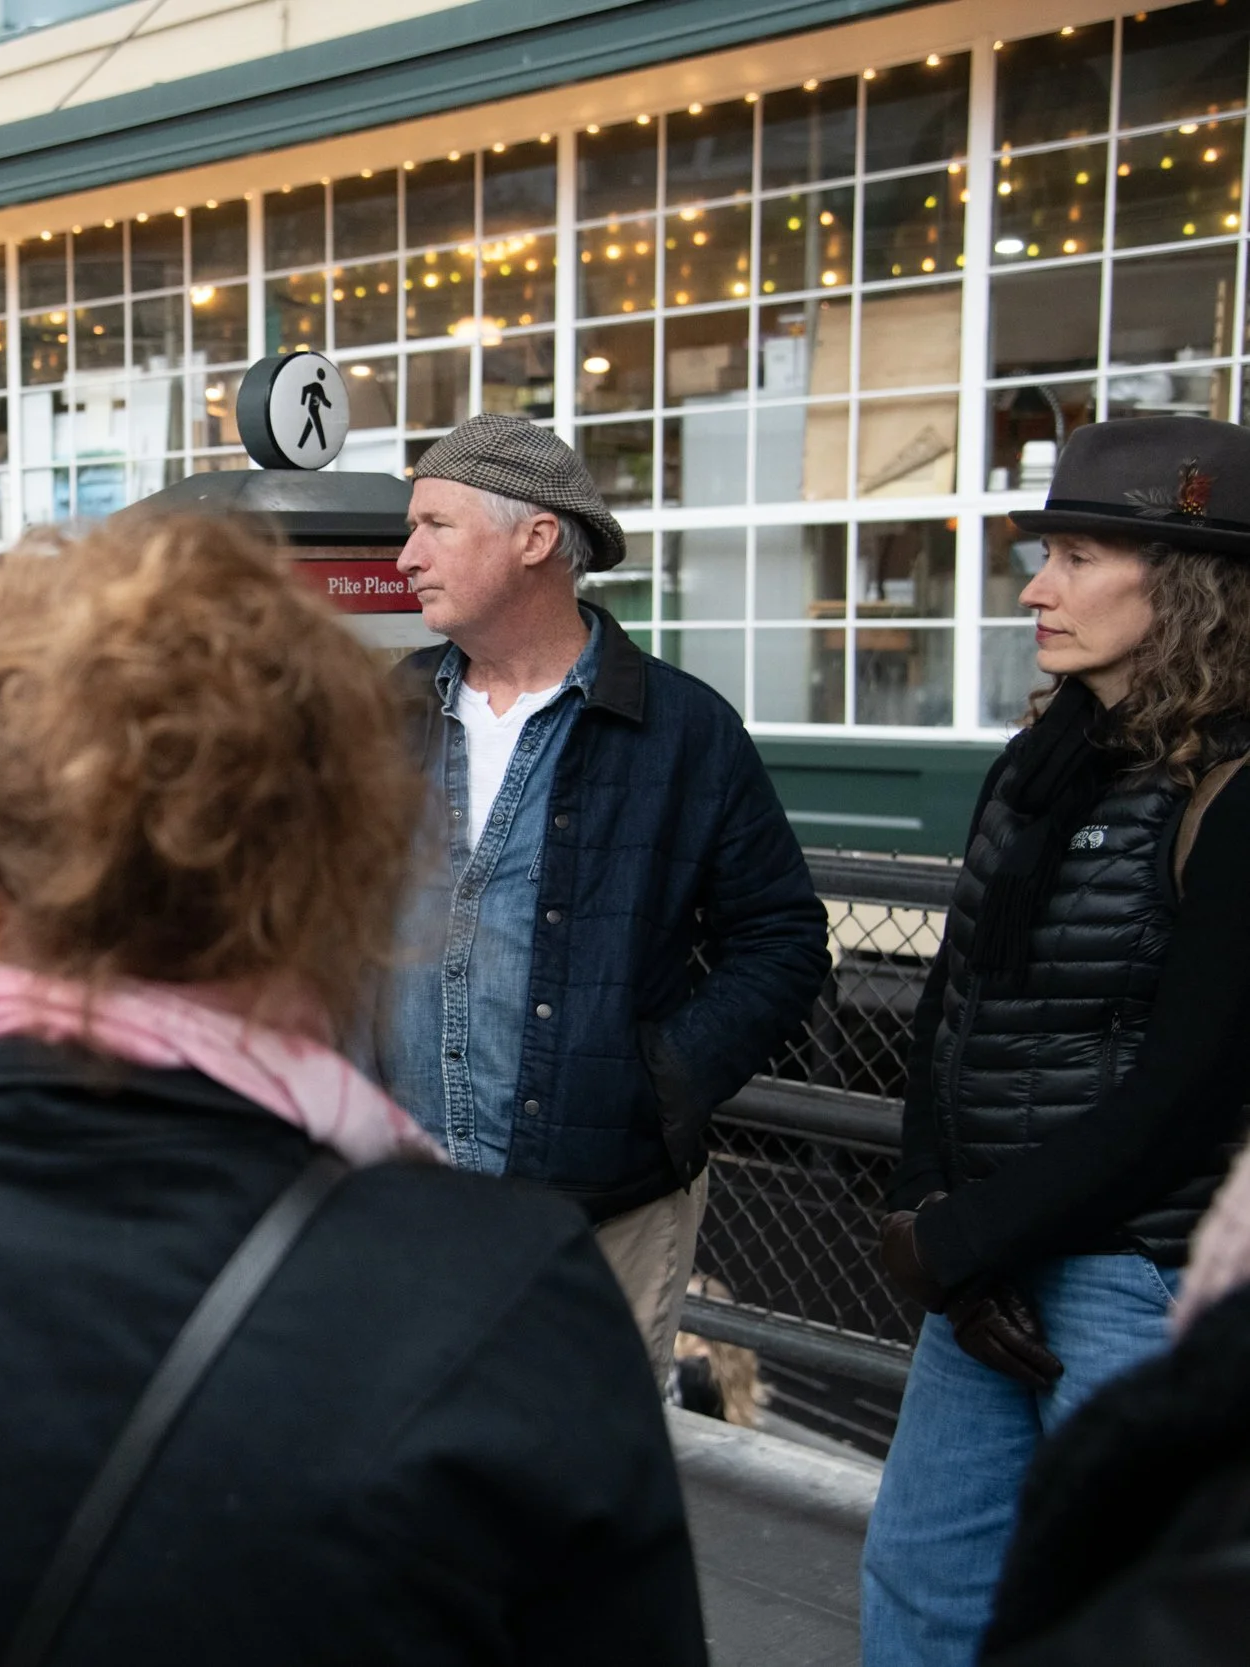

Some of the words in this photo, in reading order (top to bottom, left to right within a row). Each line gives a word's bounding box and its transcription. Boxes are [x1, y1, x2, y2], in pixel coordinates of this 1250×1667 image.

[328, 577, 361, 594] Pike
[364, 577, 404, 593] Place
[1069, 839, 1087, 850] EAR
